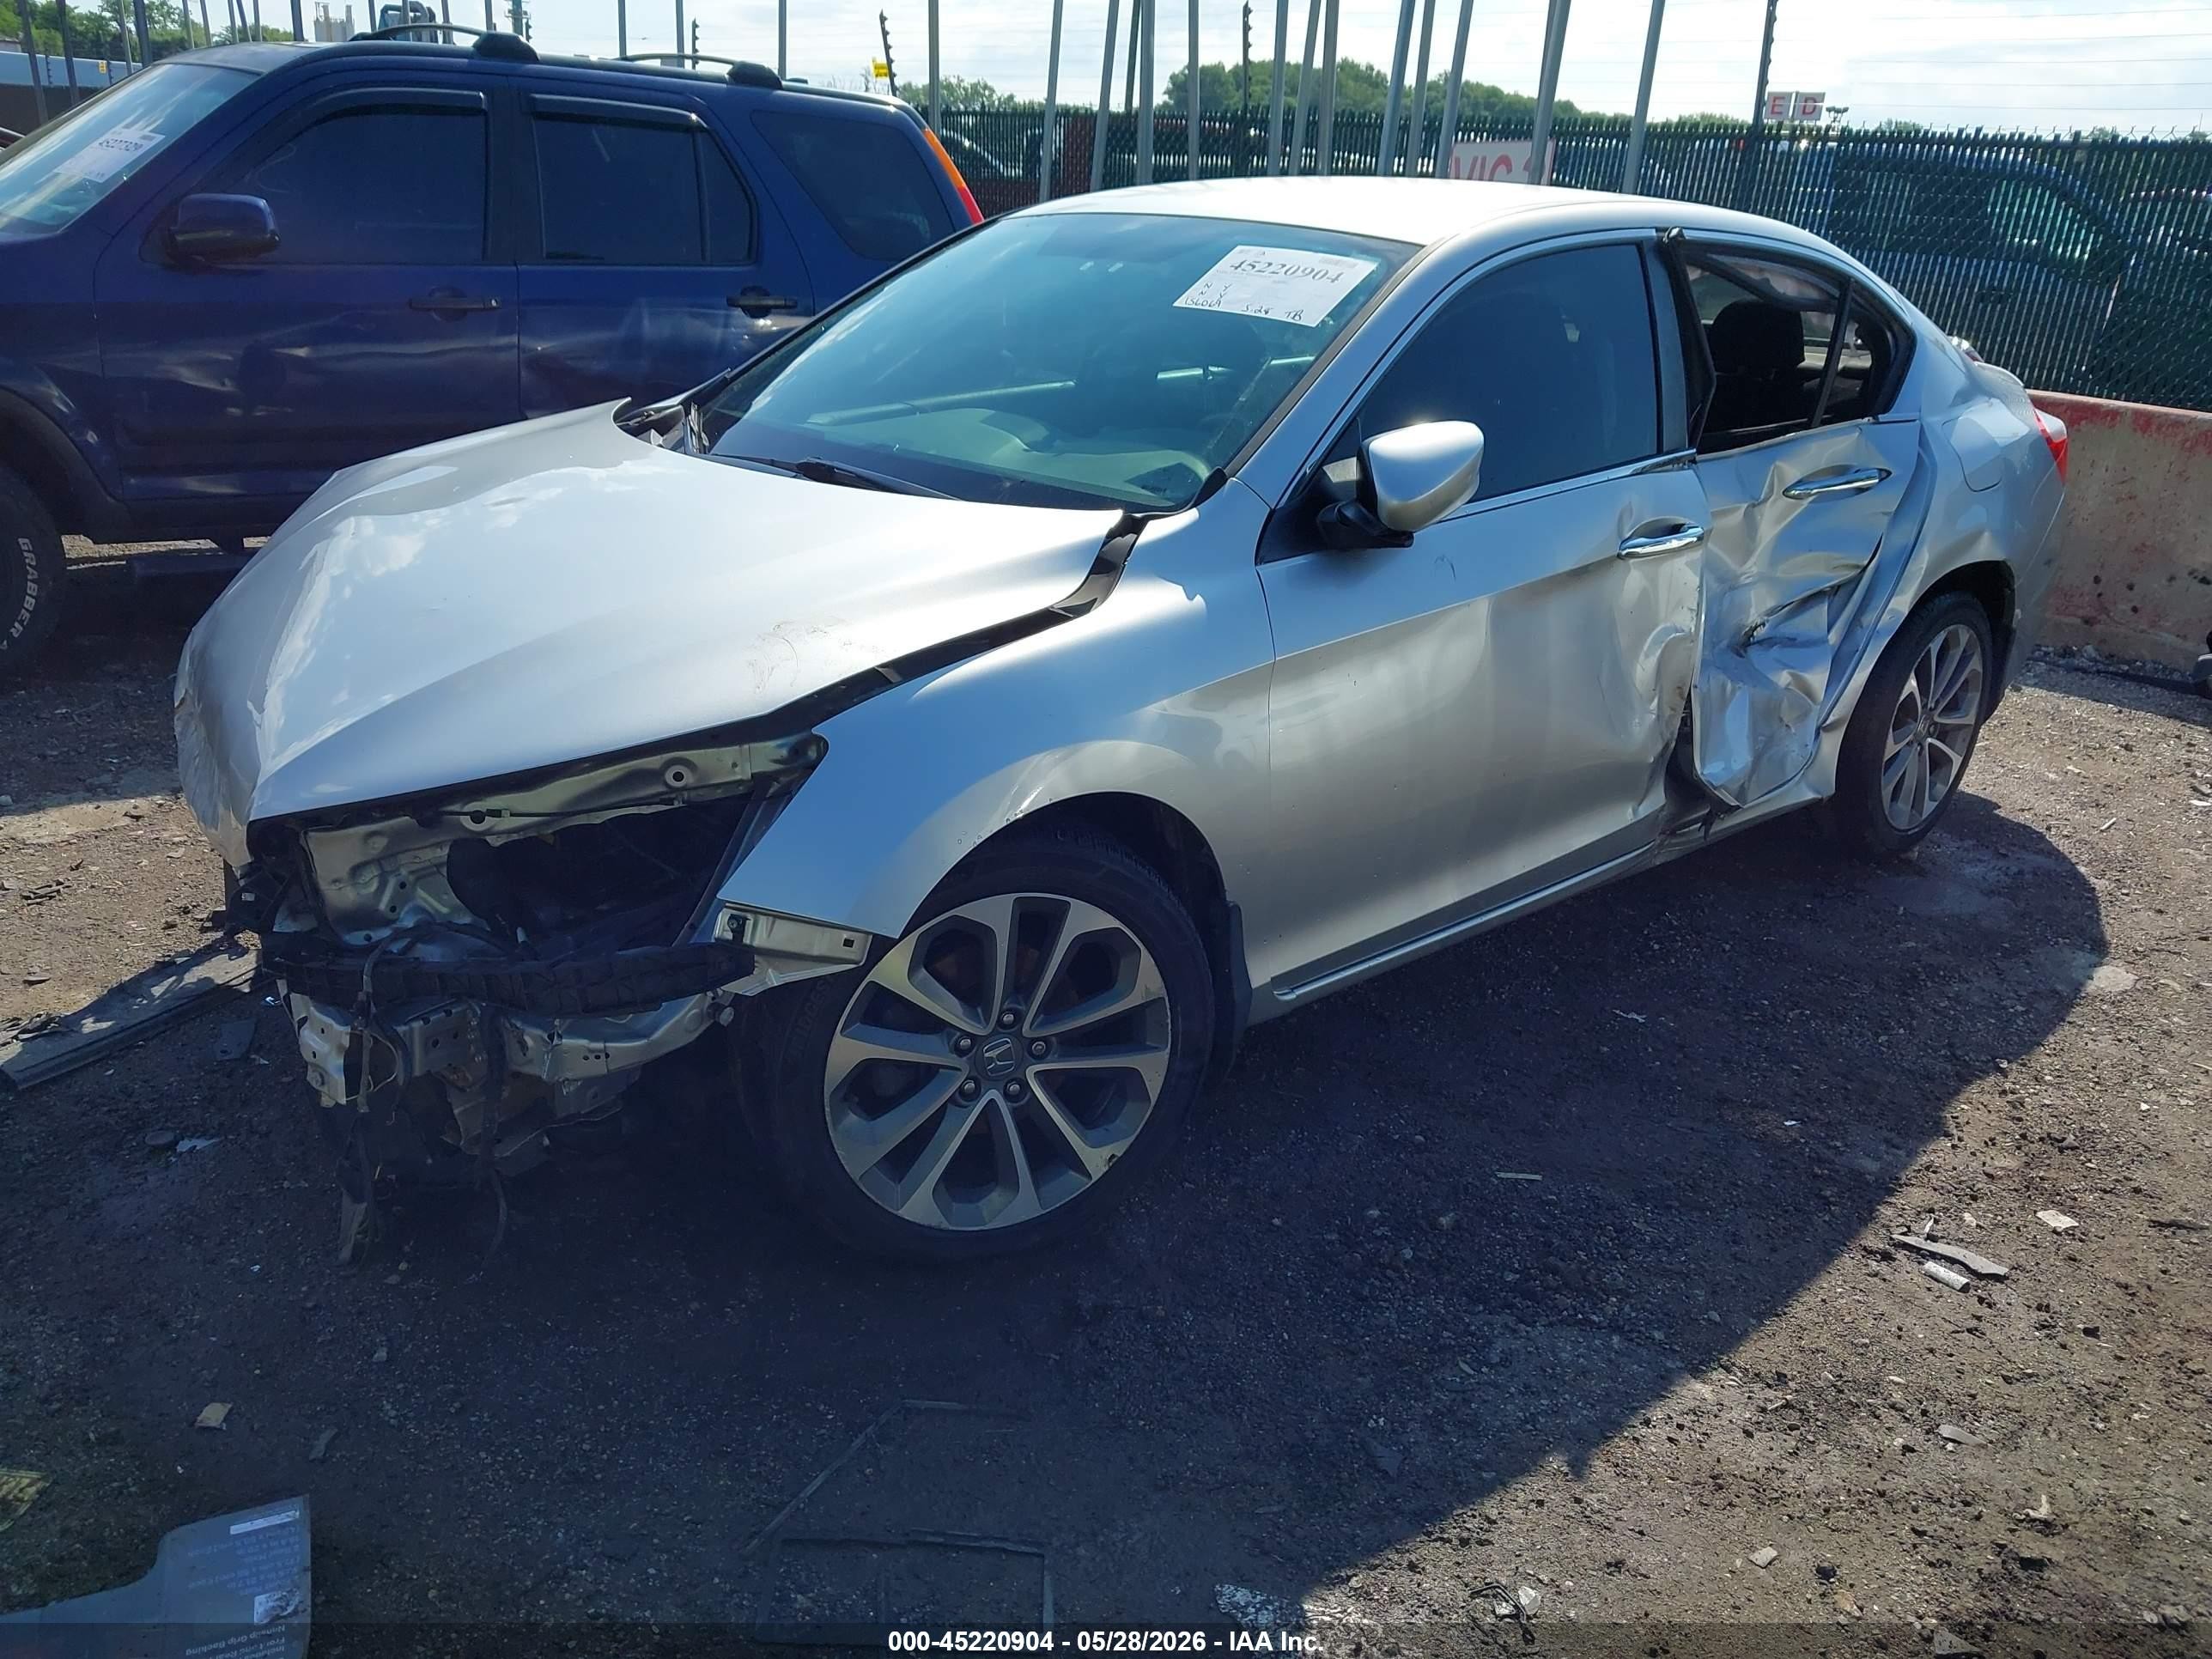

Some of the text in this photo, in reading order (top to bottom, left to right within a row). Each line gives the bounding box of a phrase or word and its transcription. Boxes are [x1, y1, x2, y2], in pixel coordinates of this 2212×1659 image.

[1771, 96, 1786, 115] E
[1802, 96, 1818, 115] D
[1229, 258, 1345, 284] 45220904
[9, 537, 40, 638] GRABBER
[185, 1641, 226, 1656] Backing
[228, 1634, 248, 1646] Grip
